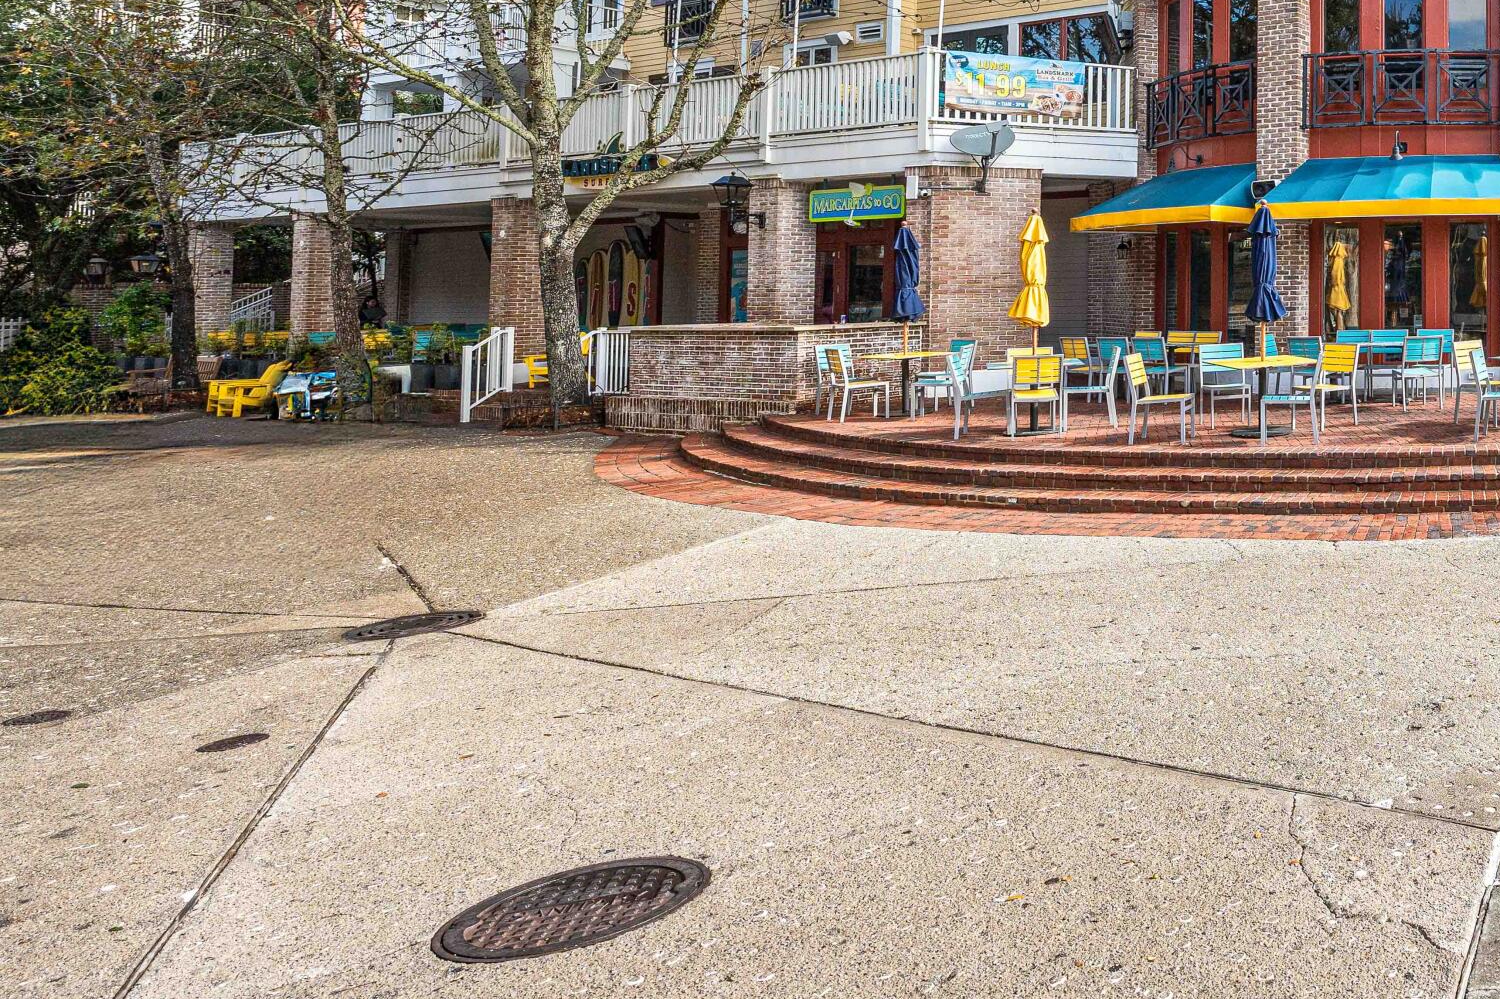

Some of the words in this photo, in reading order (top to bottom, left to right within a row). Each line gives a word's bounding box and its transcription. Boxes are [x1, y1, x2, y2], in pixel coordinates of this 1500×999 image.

[976, 59, 1011, 73] LUNCH
[1036, 68, 1075, 78] LANDSHARK
[955, 71, 1027, 99] $11.99
[882, 193, 901, 210] GO
